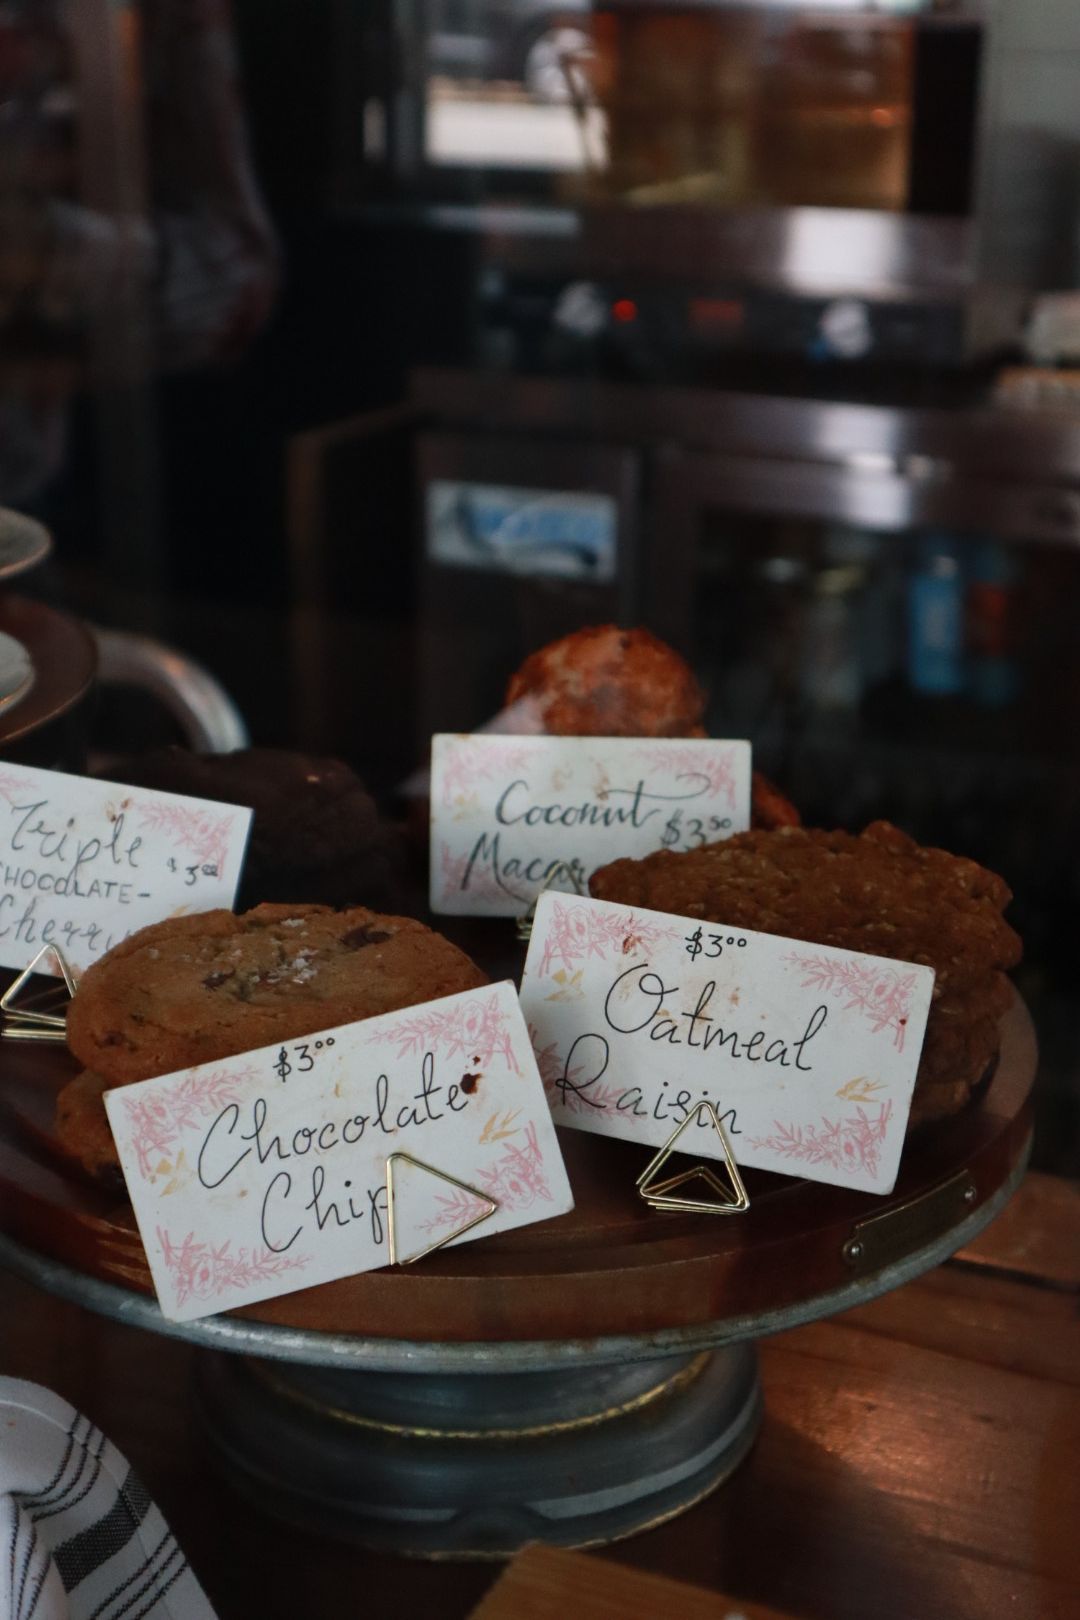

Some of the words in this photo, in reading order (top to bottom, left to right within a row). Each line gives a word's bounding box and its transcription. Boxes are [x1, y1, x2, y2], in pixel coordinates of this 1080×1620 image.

[11, 800, 143, 897] Triple
[495, 772, 712, 828] Coconut
[0, 861, 151, 904] HOCOLATE-
[604, 963, 828, 1071] Oatmeal
[197, 1052, 470, 1190] Chocolate
[555, 1034, 742, 1135] Raisin
[261, 1165, 395, 1253] Chip
